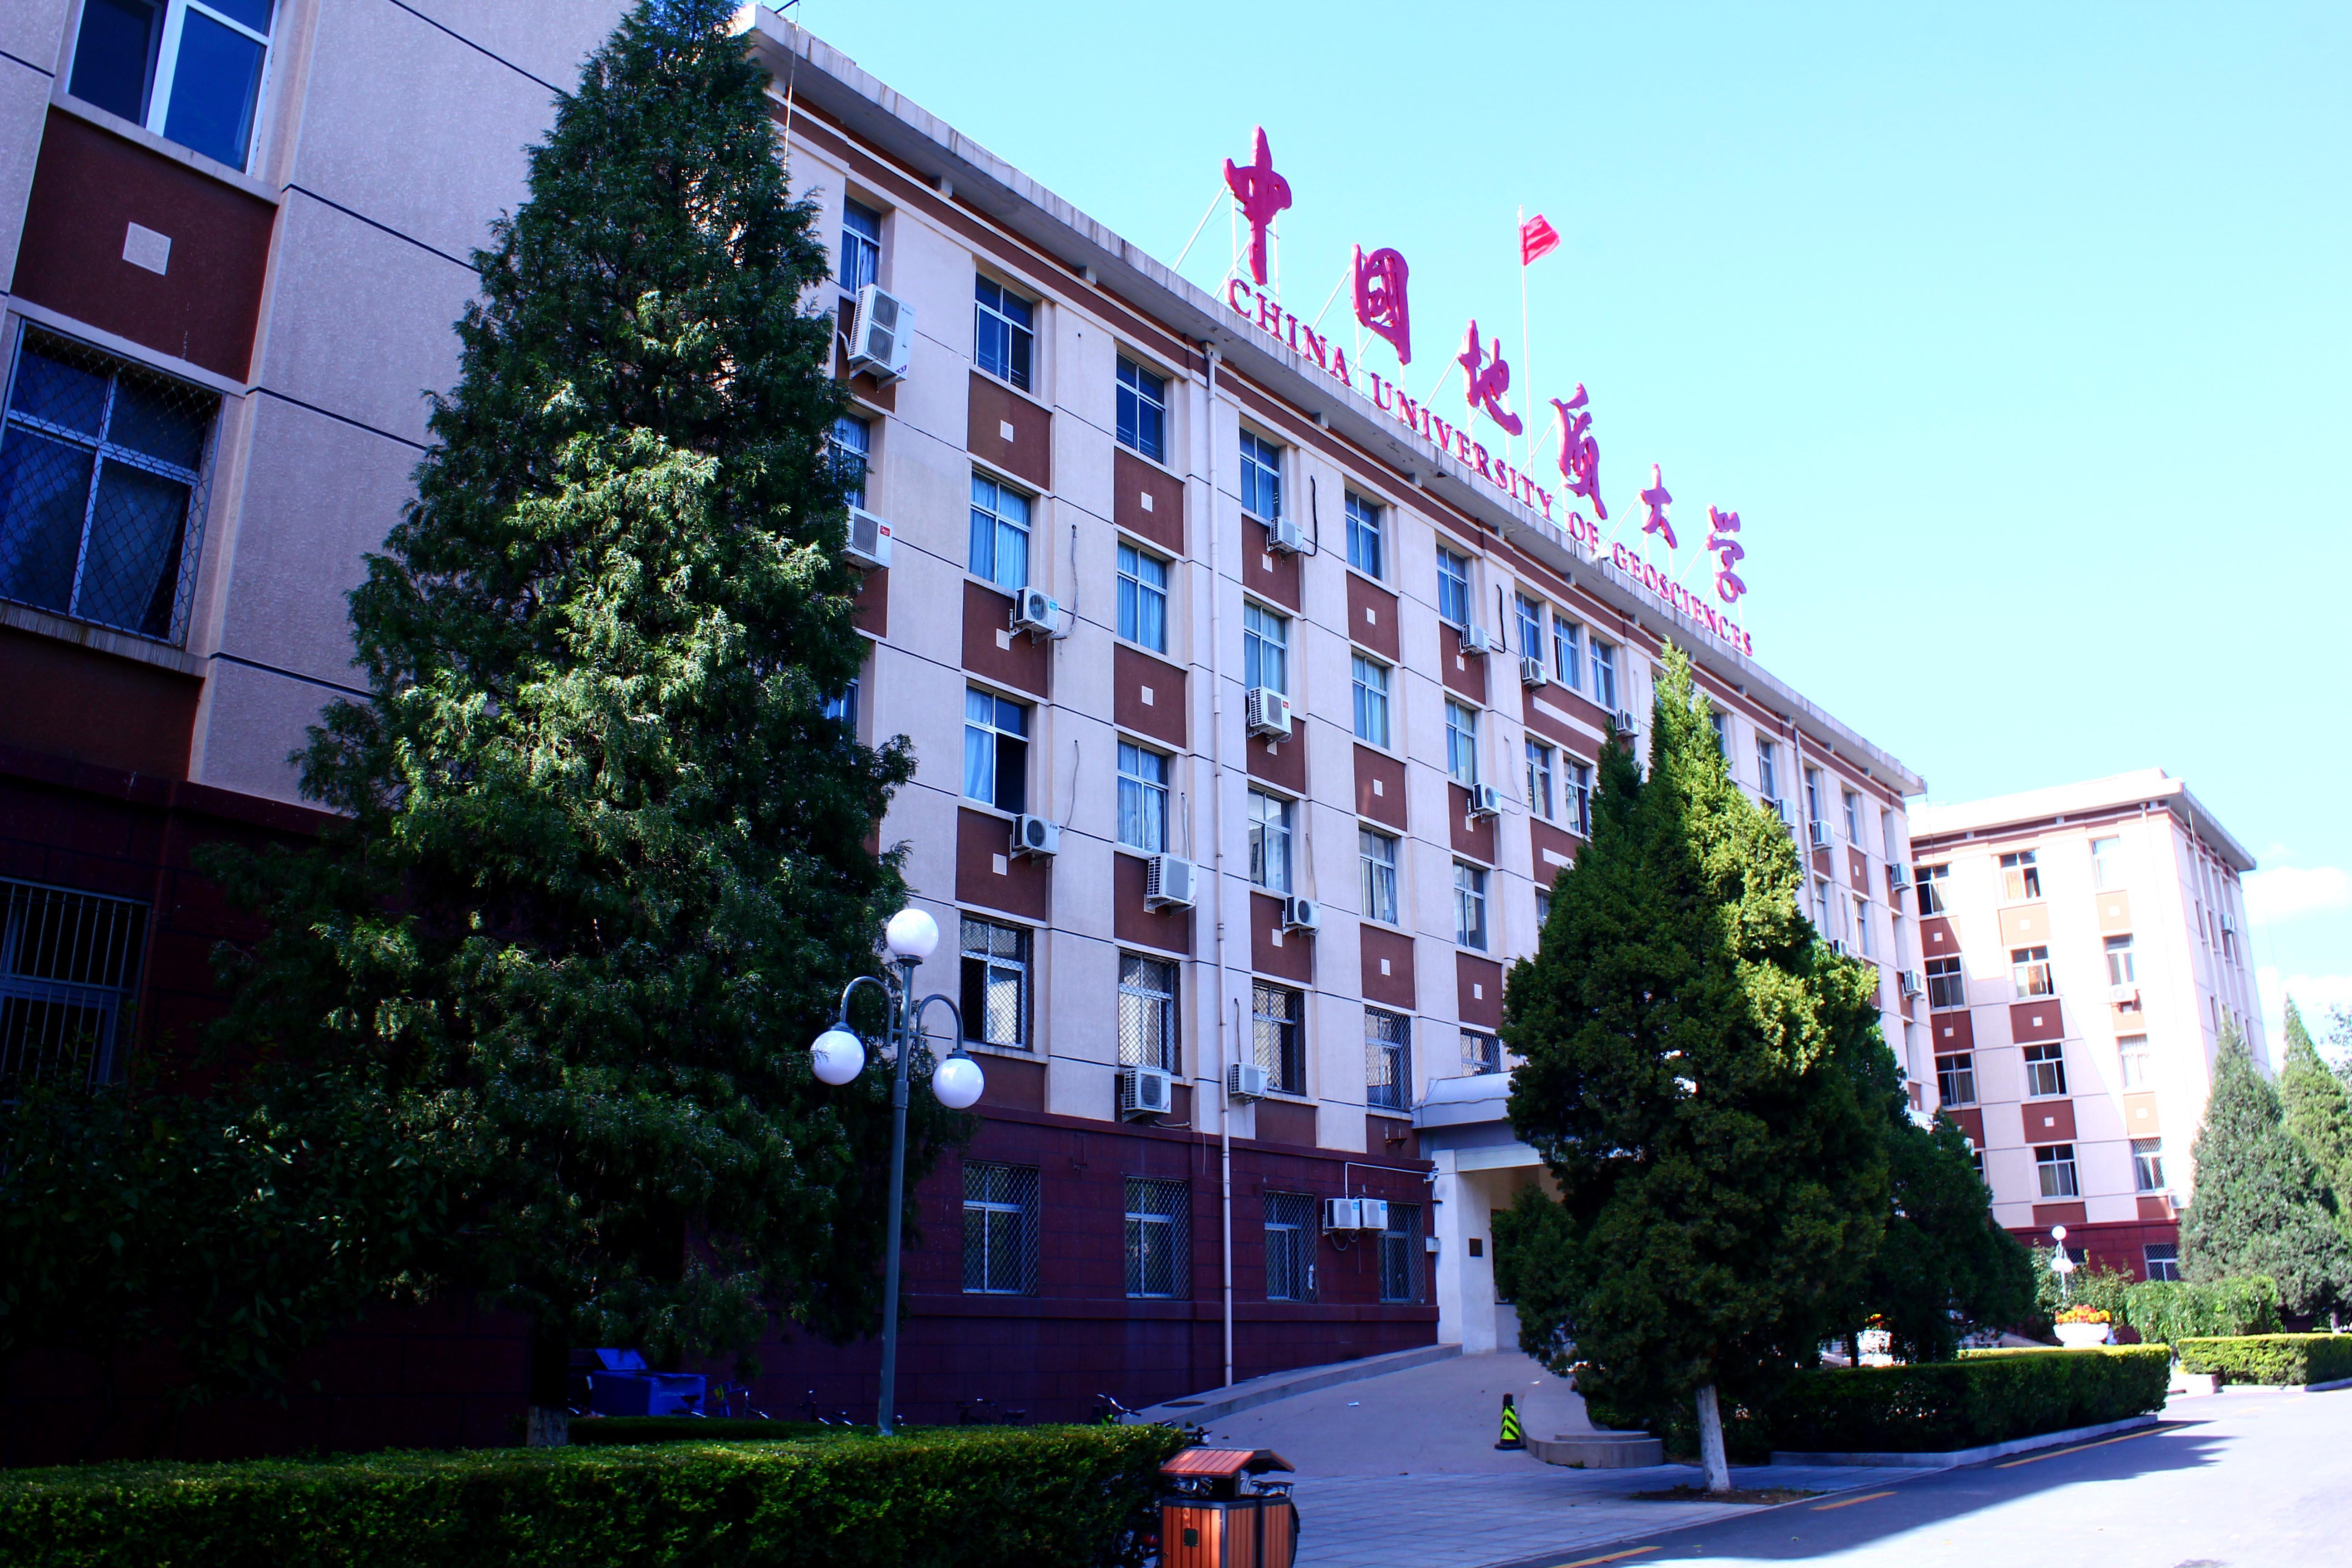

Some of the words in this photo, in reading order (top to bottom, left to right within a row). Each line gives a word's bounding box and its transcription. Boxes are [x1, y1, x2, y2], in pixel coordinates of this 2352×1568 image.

[1227, 279, 1352, 387] CHINA
[1371, 372, 1553, 521] UNIVERSITY
[1568, 511, 1599, 552] OF
[1612, 542, 1752, 657] GEOSCIENCES
